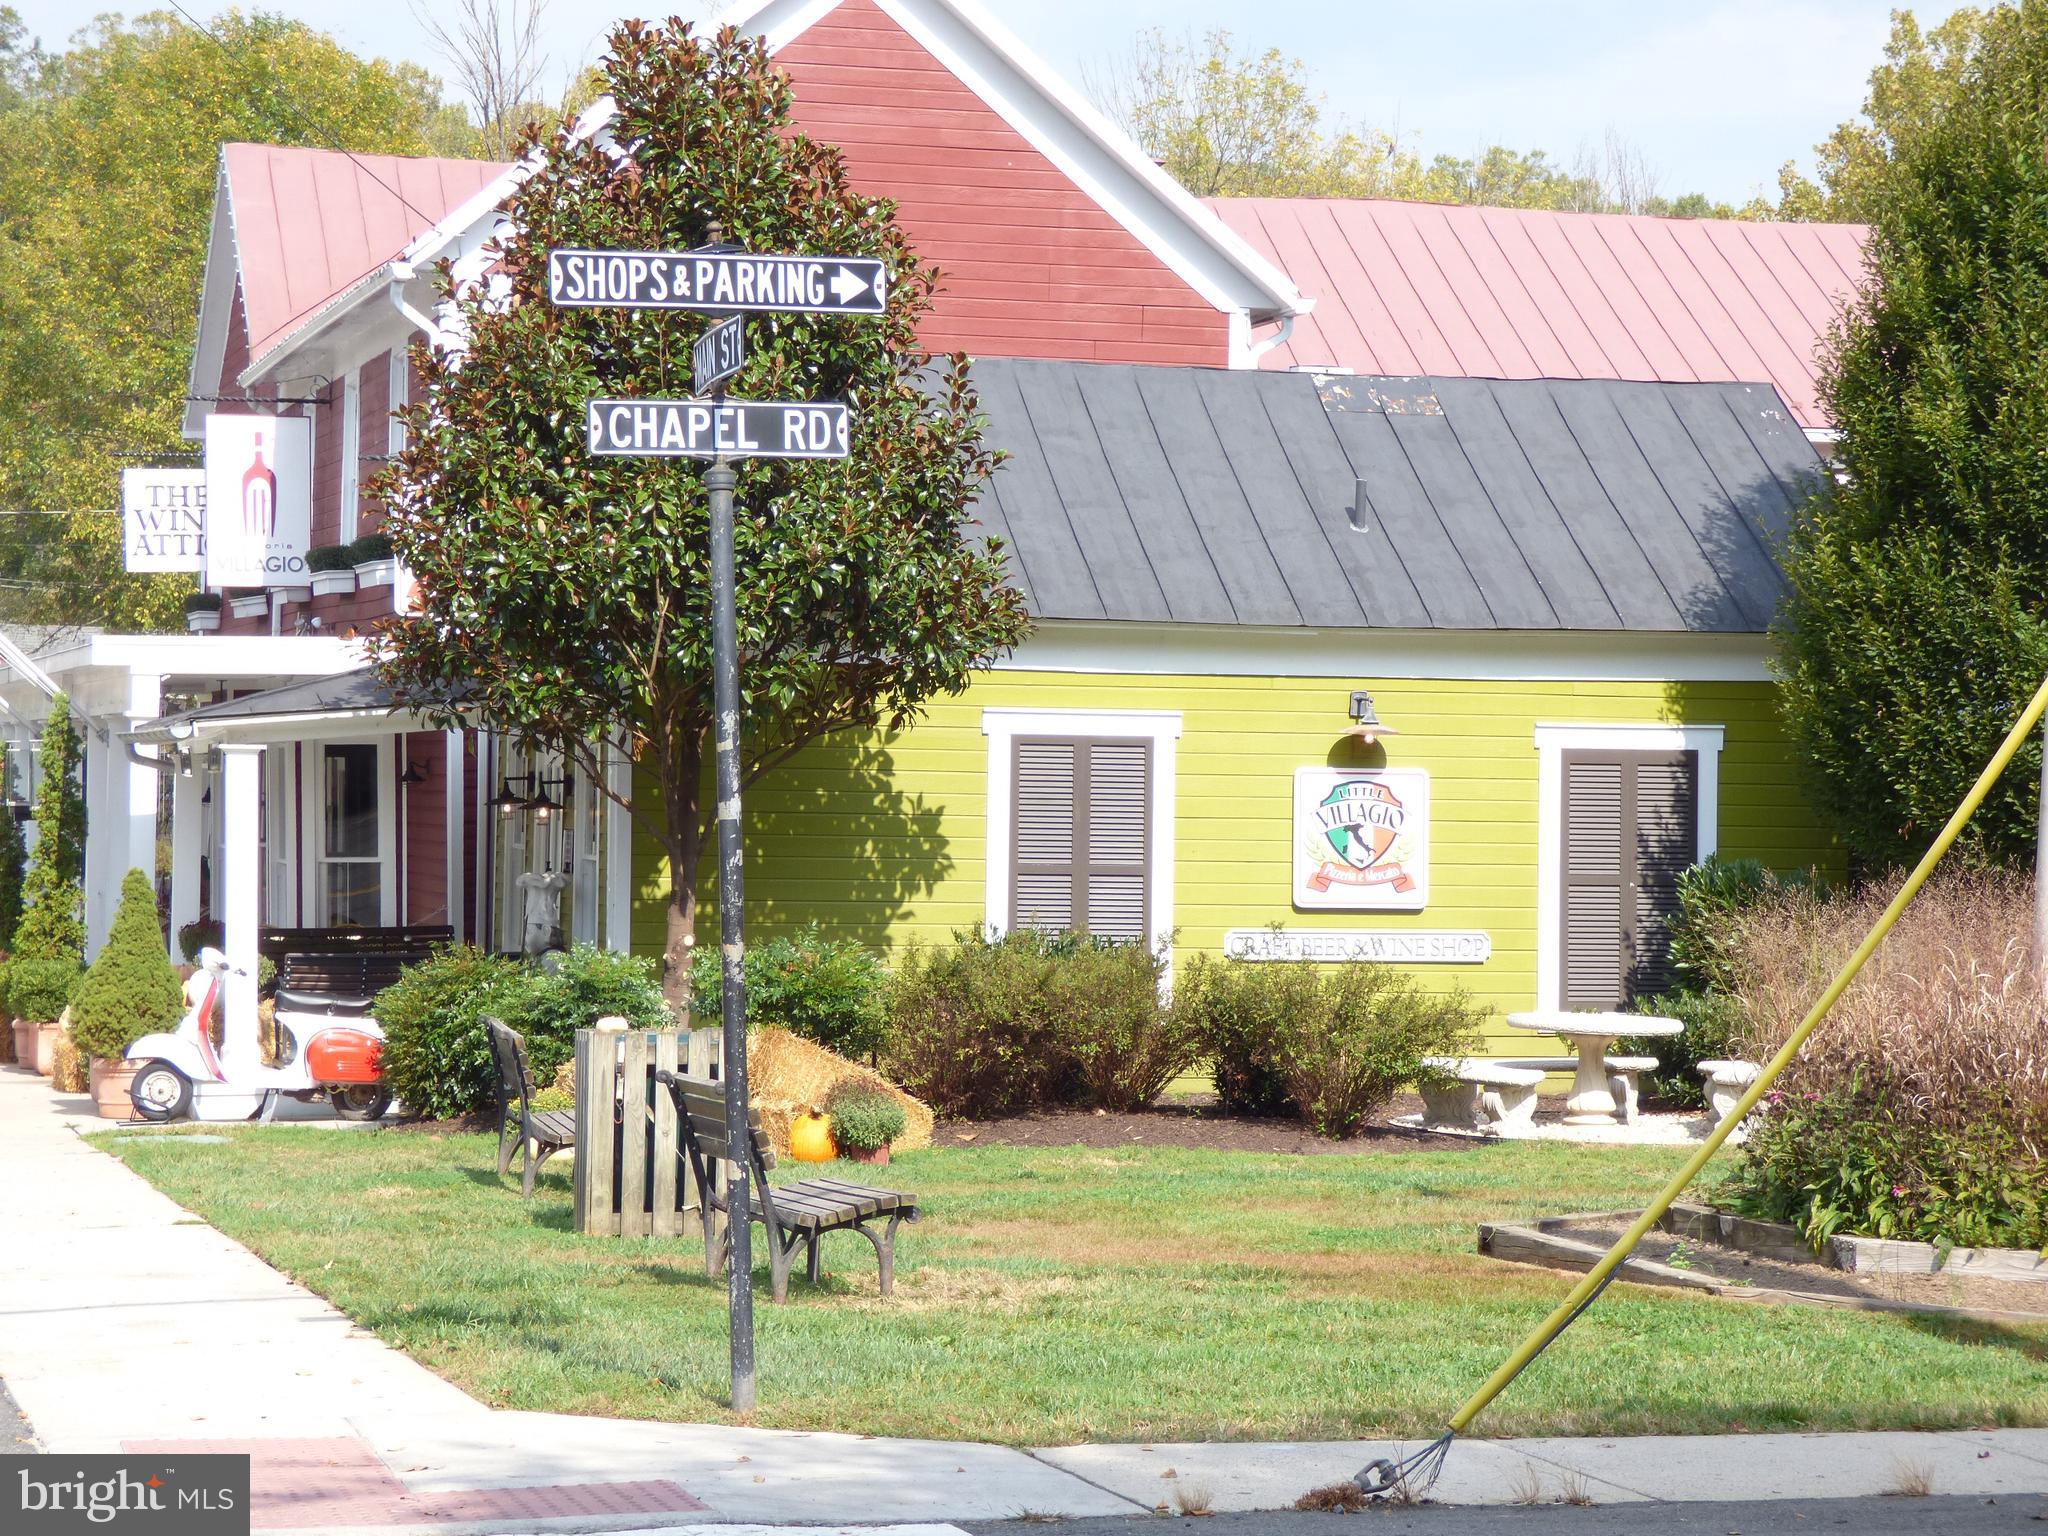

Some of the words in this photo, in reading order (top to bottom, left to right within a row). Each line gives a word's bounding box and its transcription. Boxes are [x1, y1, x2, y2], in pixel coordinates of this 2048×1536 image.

[567, 256, 668, 301] SHOPS
[696, 260, 825, 305] PARKING
[696, 336, 716, 388] MAIN
[720, 324, 737, 370] ST
[609, 406, 758, 450] CHAPEL
[784, 409, 831, 450] RD
[145, 485, 206, 507] THE
[133, 509, 206, 531] WIN
[133, 534, 206, 556] ATTI
[216, 556, 303, 573] VILLAGIO
[1339, 787, 1384, 799] LITTLE
[1316, 802, 1405, 829] VILLAGIO
[1301, 937, 1351, 956] BEER
[1430, 938, 1485, 957] SHOP
